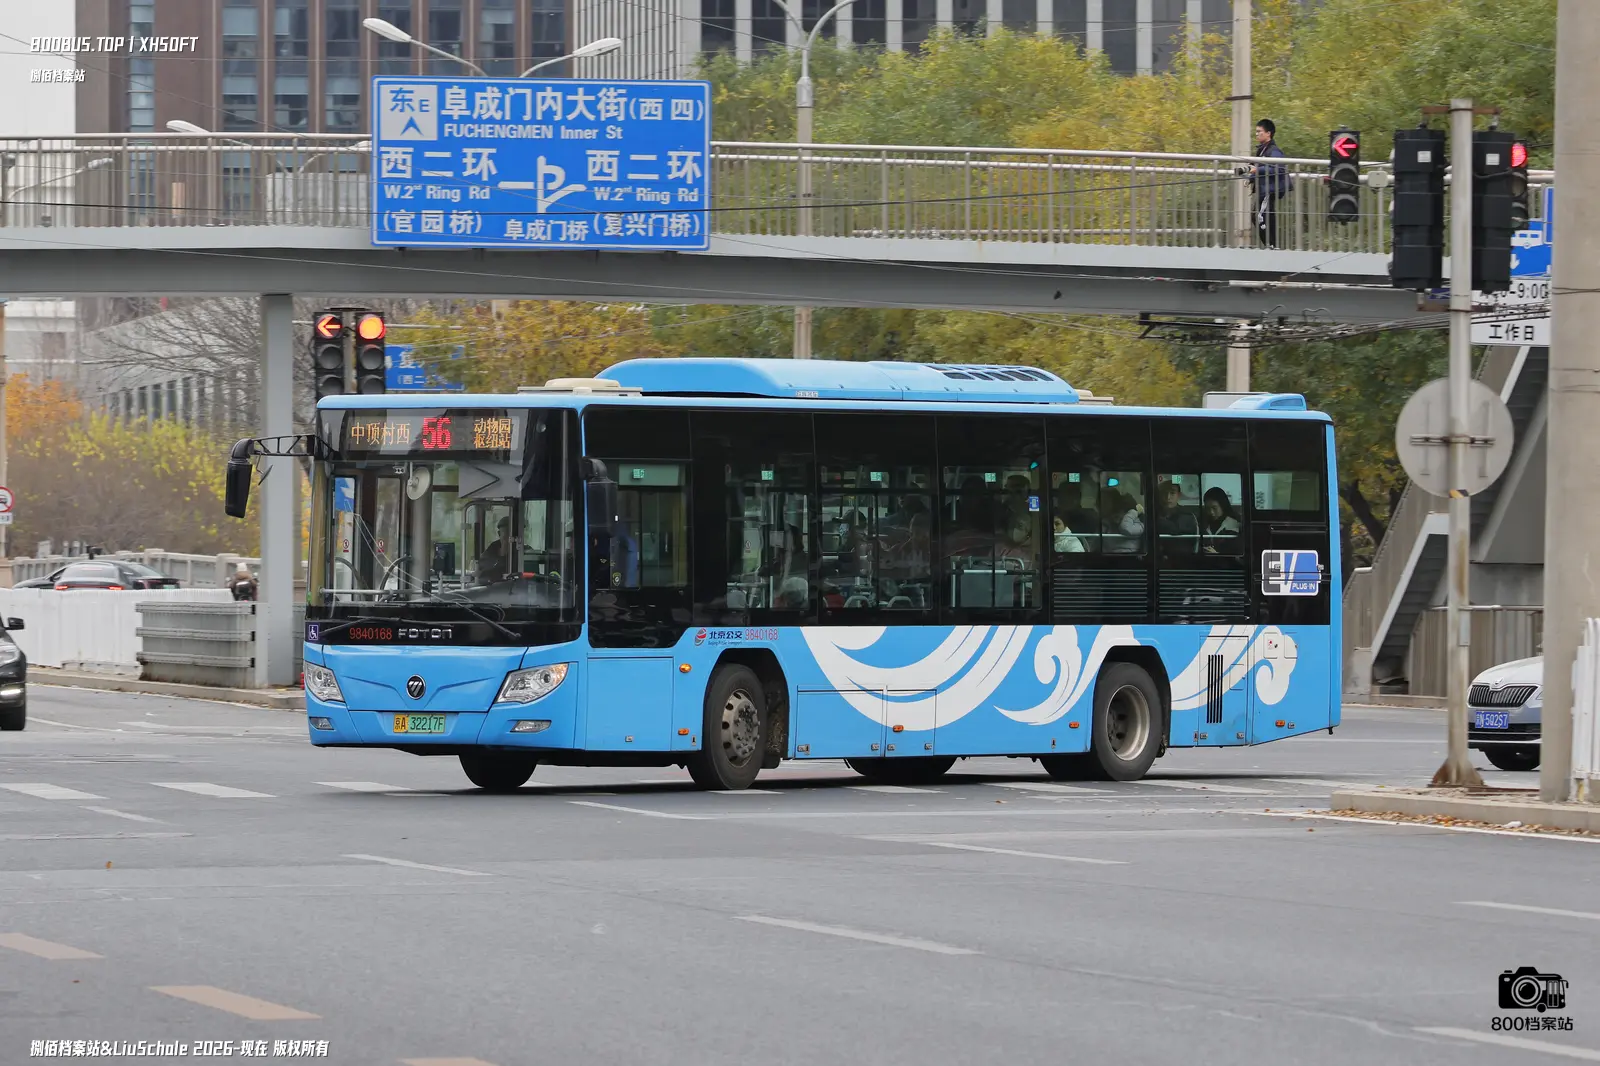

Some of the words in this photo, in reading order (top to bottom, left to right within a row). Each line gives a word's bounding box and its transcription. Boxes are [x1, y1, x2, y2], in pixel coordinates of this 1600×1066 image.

[389, 87, 415, 113] 东
[420, 100, 430, 113] E
[444, 123, 553, 140] FUCHENGMEN
[560, 126, 599, 140] Inner
[605, 125, 623, 140] St
[379, 146, 498, 181] 西二环
[585, 149, 702, 184] 西二环
[426, 185, 461, 202] Ring
[469, 185, 491, 200] Rd
[636, 187, 671, 204] Ring
[678, 187, 699, 202] Rd
[503, 218, 589, 241] 阜成门桥
[1488, 323, 1535, 341] 工作日
[351, 421, 410, 446] 中顶村西
[422, 417, 451, 449] 56
[474, 417, 512, 433] 动物园
[474, 433, 512, 449] 枢纽站
[350, 627, 393, 640] 9840168
[709, 630, 743, 640] 北京公交
[745, 628, 779, 640] 9840168
